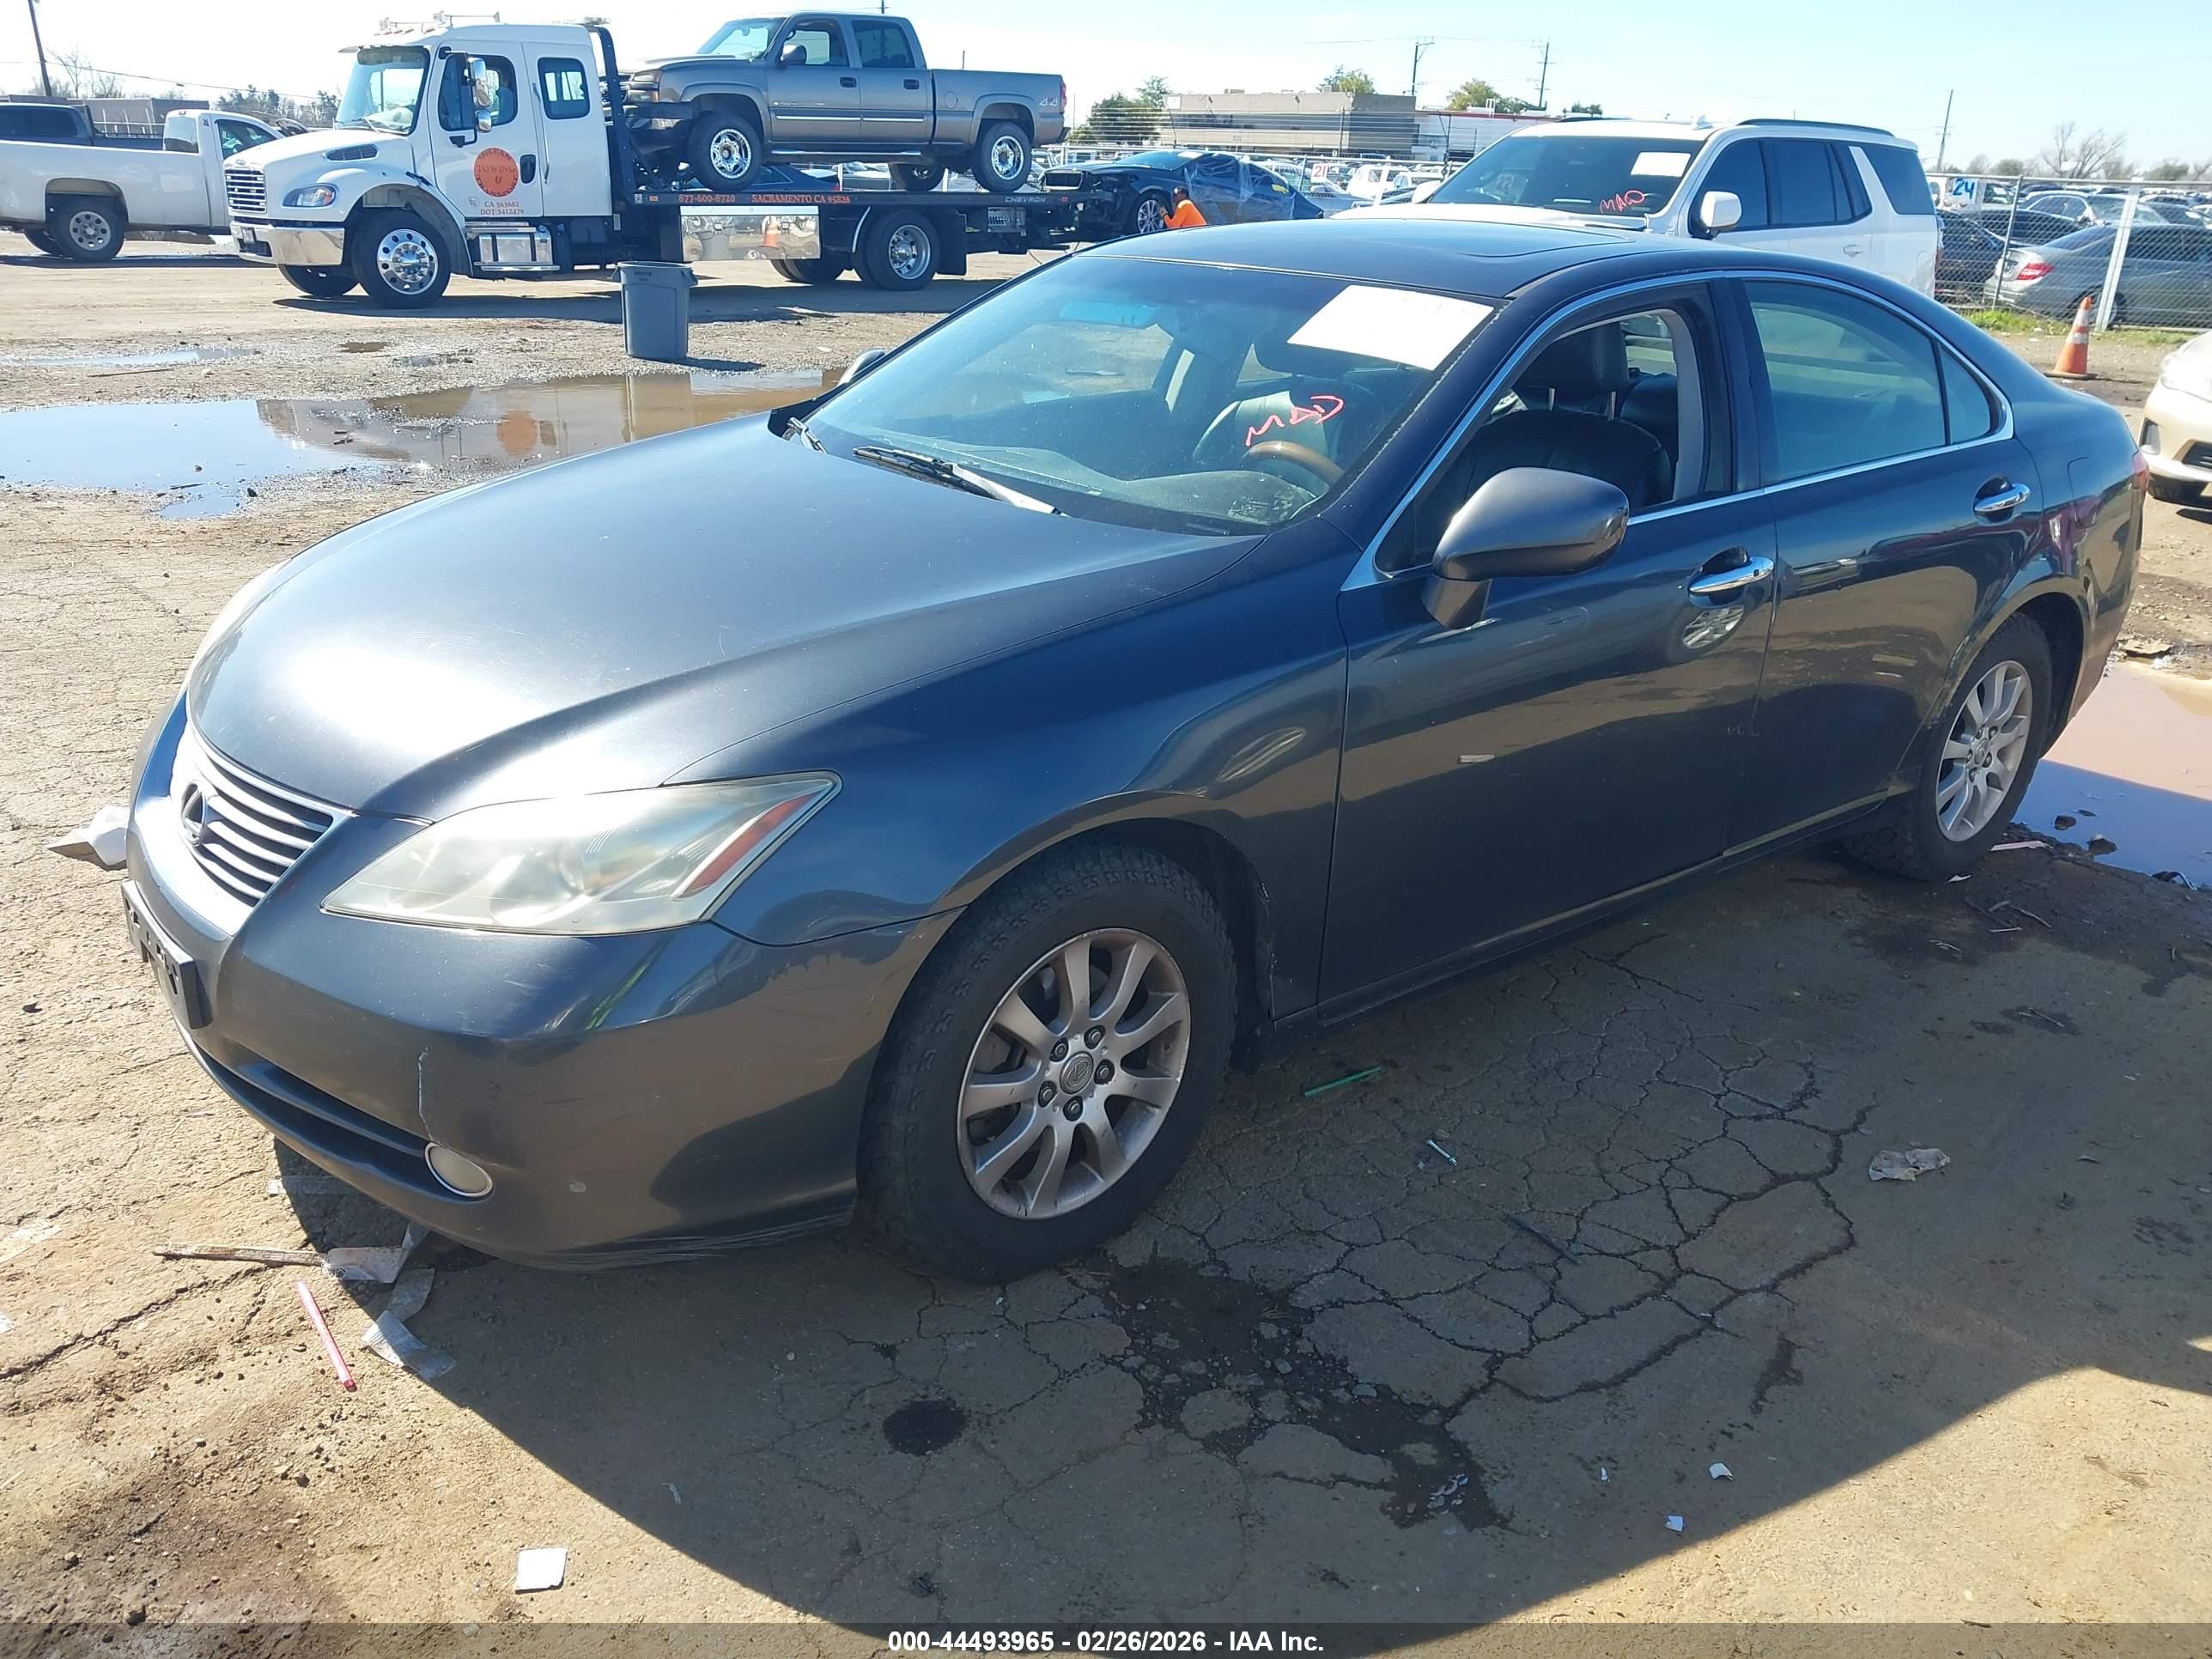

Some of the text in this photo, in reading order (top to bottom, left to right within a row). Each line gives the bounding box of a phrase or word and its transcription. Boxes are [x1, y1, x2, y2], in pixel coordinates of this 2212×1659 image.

[477, 164, 516, 173] TOWING
[1314, 165, 1327, 178] 21
[495, 175, 502, 184] &
[1953, 178, 1975, 199] 24
[678, 193, 851, 204] 877-600-8720 SACRAMENTO CA 95826
